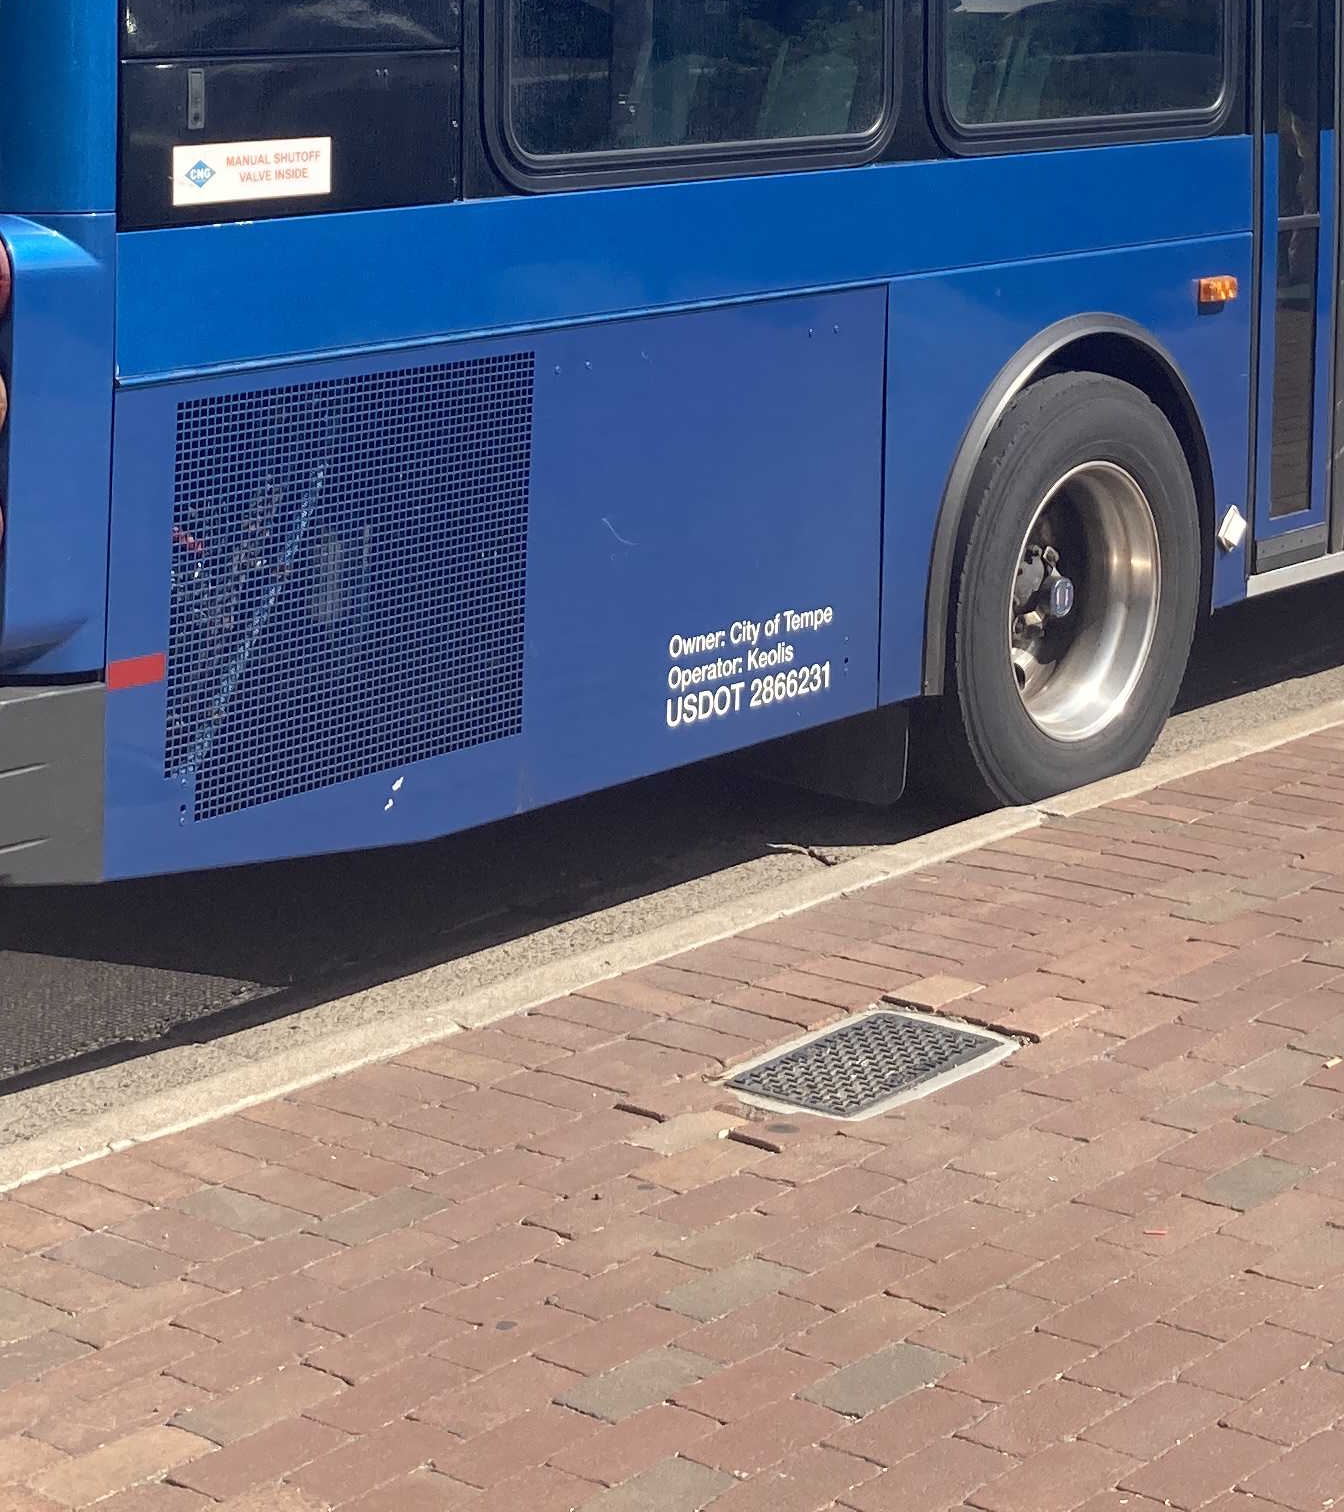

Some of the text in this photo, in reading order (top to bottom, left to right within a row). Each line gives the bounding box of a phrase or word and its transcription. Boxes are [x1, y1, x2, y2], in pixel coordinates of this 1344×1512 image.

[226, 150, 321, 167] MANUAL SHUTOFF
[239, 167, 309, 183] VALVE INSIDE
[669, 606, 833, 658] Owner: City of Tempe
[667, 642, 794, 692] Operator: Keolis
[666, 661, 831, 728] USDOT 2866231
